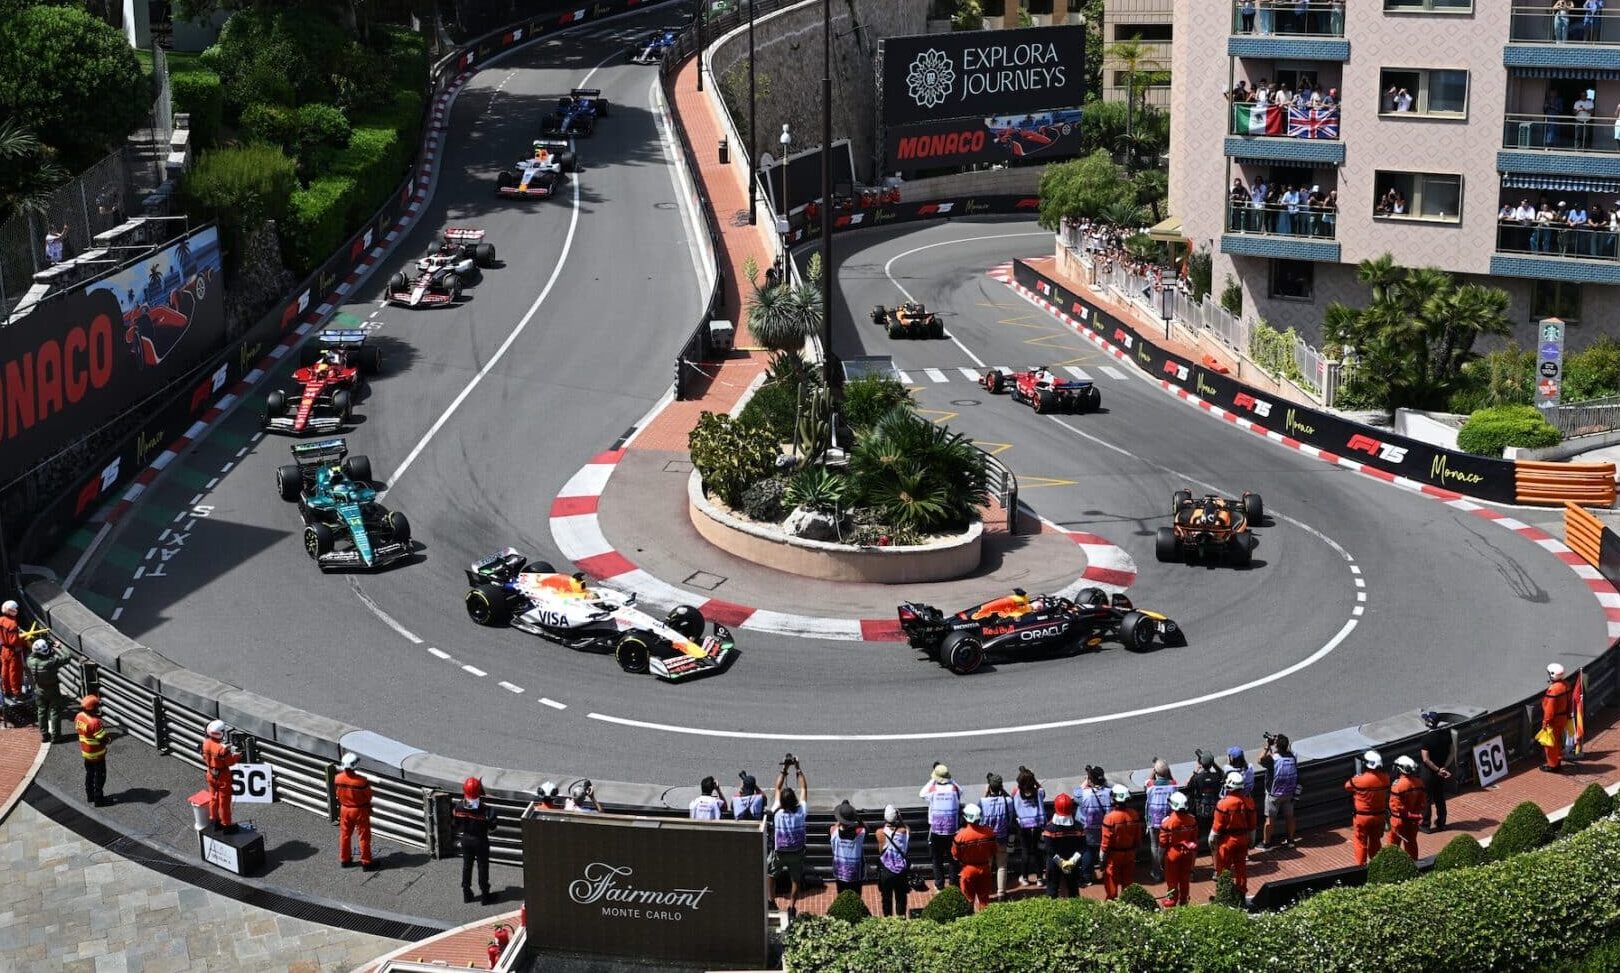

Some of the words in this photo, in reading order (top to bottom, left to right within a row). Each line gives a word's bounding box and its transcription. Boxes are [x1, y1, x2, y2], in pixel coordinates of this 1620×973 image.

[963, 42, 1059, 70] EXPLORA
[961, 66, 1066, 101] JOURNEYS
[897, 130, 985, 160] MONACO
[0, 314, 112, 442] NACO
[1430, 454, 1484, 485] Monaco
[538, 610, 570, 627] VISA
[1479, 744, 1504, 778] SC
[231, 769, 267, 797] SC
[568, 862, 713, 910] Fairmont
[601, 907, 641, 919] MONTE
[646, 910, 682, 921] CARLO
